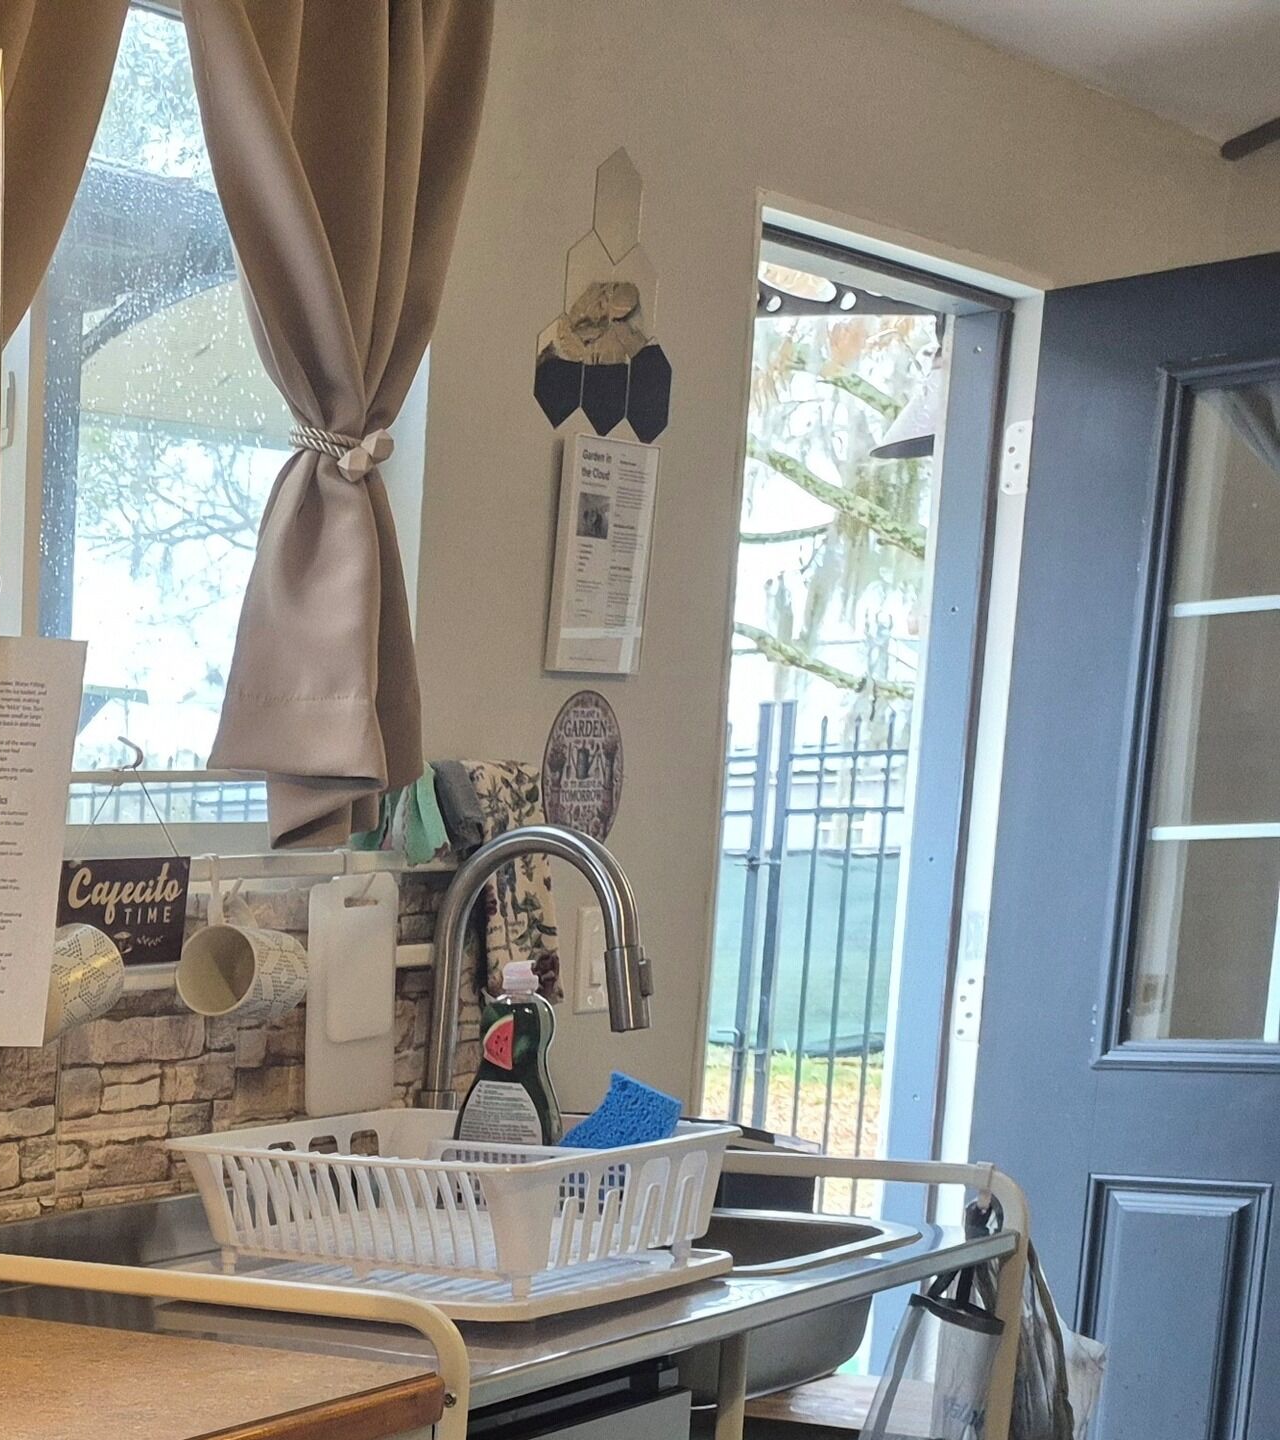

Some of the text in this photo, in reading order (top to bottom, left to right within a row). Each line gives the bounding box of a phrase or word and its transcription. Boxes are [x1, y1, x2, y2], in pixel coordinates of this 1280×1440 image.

[582, 449, 605, 462] Garden
[581, 467, 591, 478] the
[564, 719, 608, 738] GARDEN
[561, 789, 603, 803] TOMORROW
[68, 862, 183, 925] Cafecito
[123, 906, 172, 925] TIME
